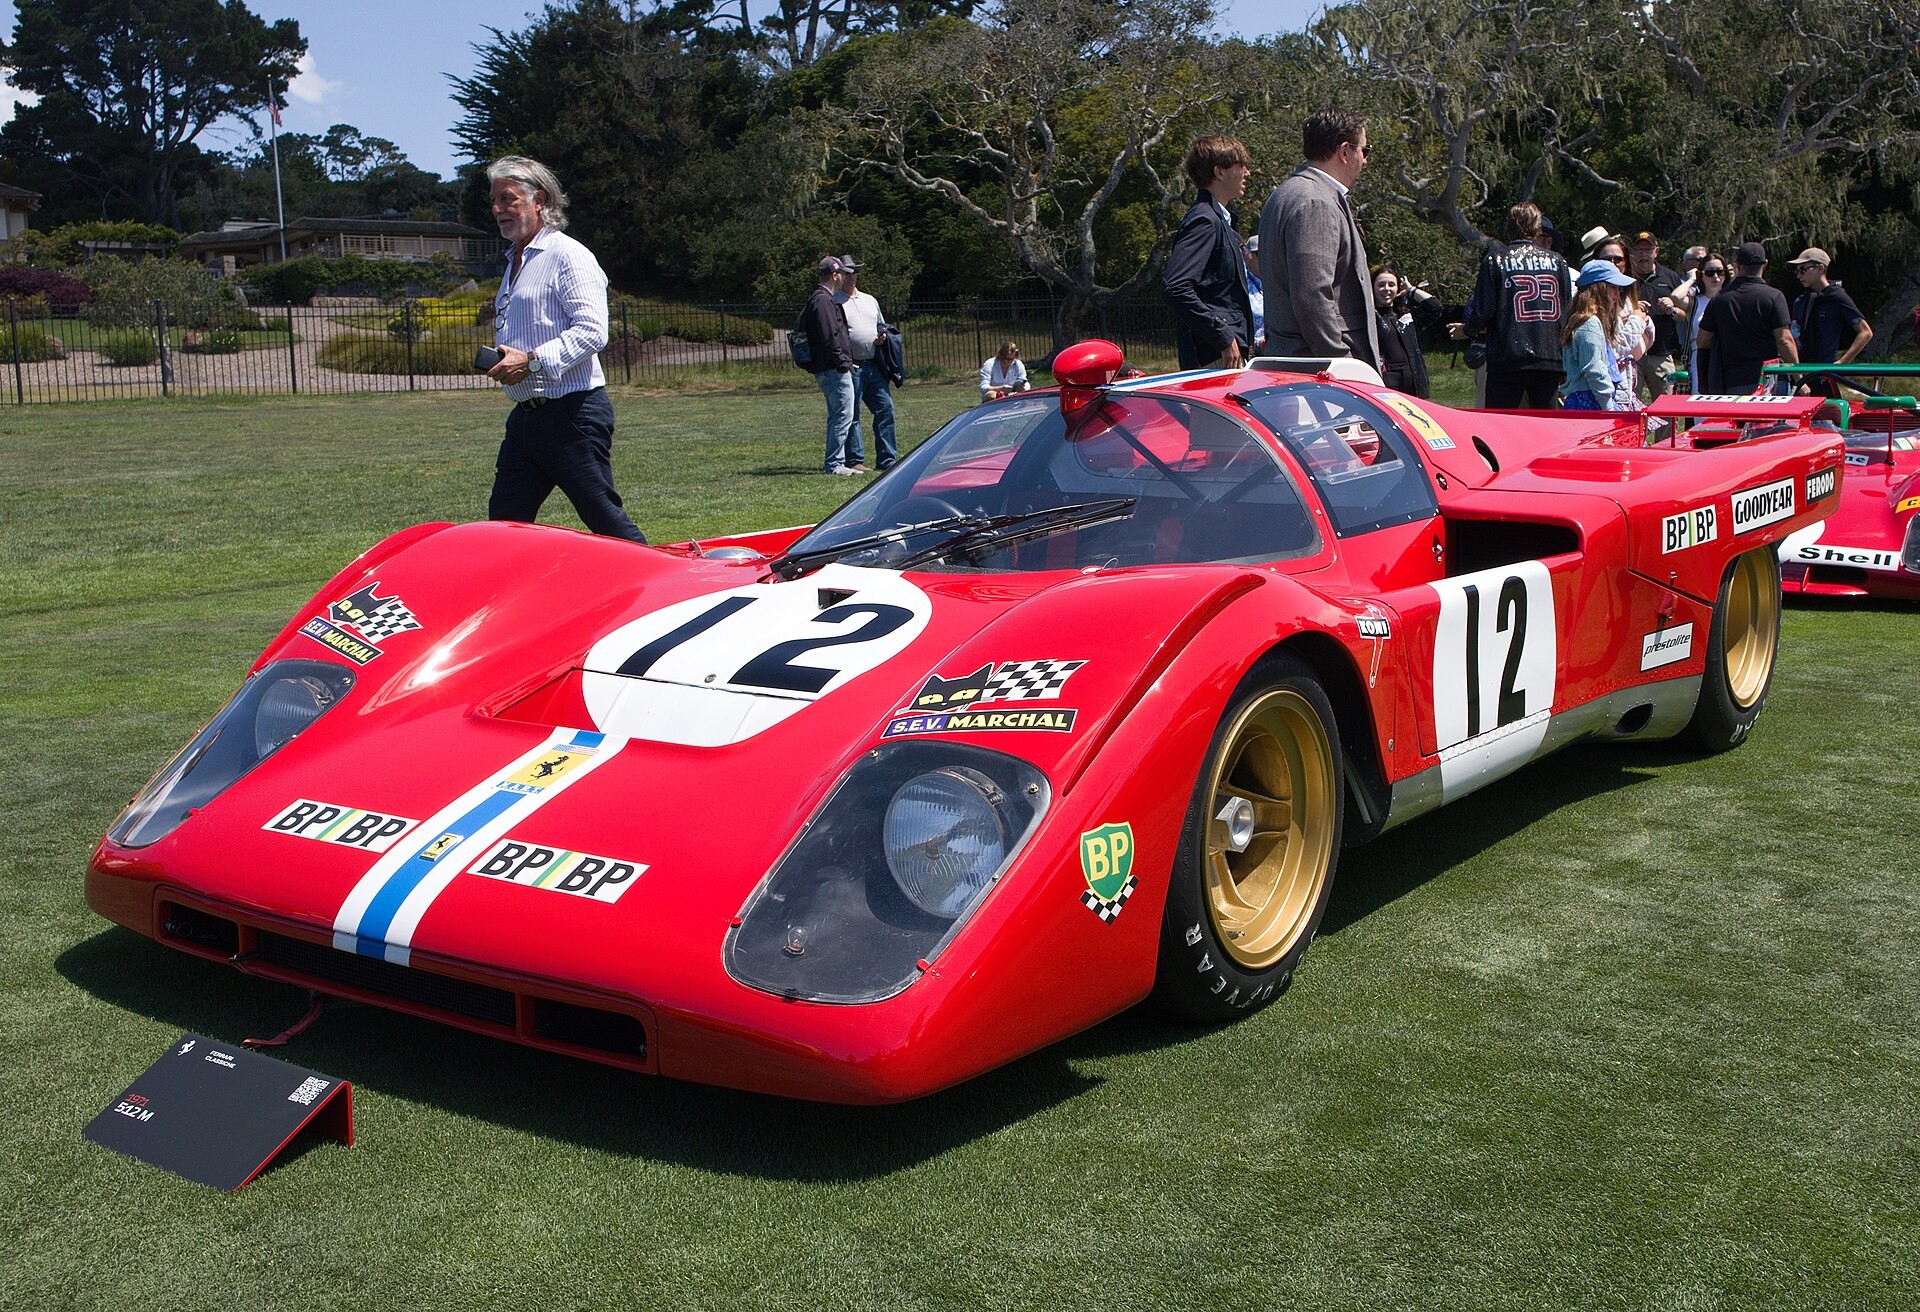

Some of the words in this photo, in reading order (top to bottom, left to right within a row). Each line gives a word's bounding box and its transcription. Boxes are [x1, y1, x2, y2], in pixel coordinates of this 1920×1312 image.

[1504, 256, 1524, 271] LAS
[1526, 256, 1558, 271] VEGAS
[1807, 471, 1834, 500] FERODO
[1735, 485, 1793, 525] GOODYEAR
[1666, 516, 1687, 551] BP
[1696, 508, 1714, 543] BP
[1798, 547, 1892, 566] Shell
[1358, 620, 1388, 635] KONI
[320, 629, 374, 662] MARCHAL
[615, 596, 915, 694] 12
[1462, 575, 1528, 738] 12
[1643, 634, 1691, 658] prestolite
[892, 717, 942, 734] S.E.V.
[946, 713, 1068, 729] MARCHAL
[271, 802, 341, 834] BP
[335, 814, 407, 847] BP
[477, 842, 555, 880] BP
[555, 857, 635, 896] BP
[1085, 831, 1129, 882] BP
[204, 1055, 236, 1069] CLASSICHE
[209, 1050, 234, 1061] FERRARI
[114, 1101, 141, 1118] 512
[137, 1109, 155, 1122] M
[125, 1093, 150, 1107] 1971
